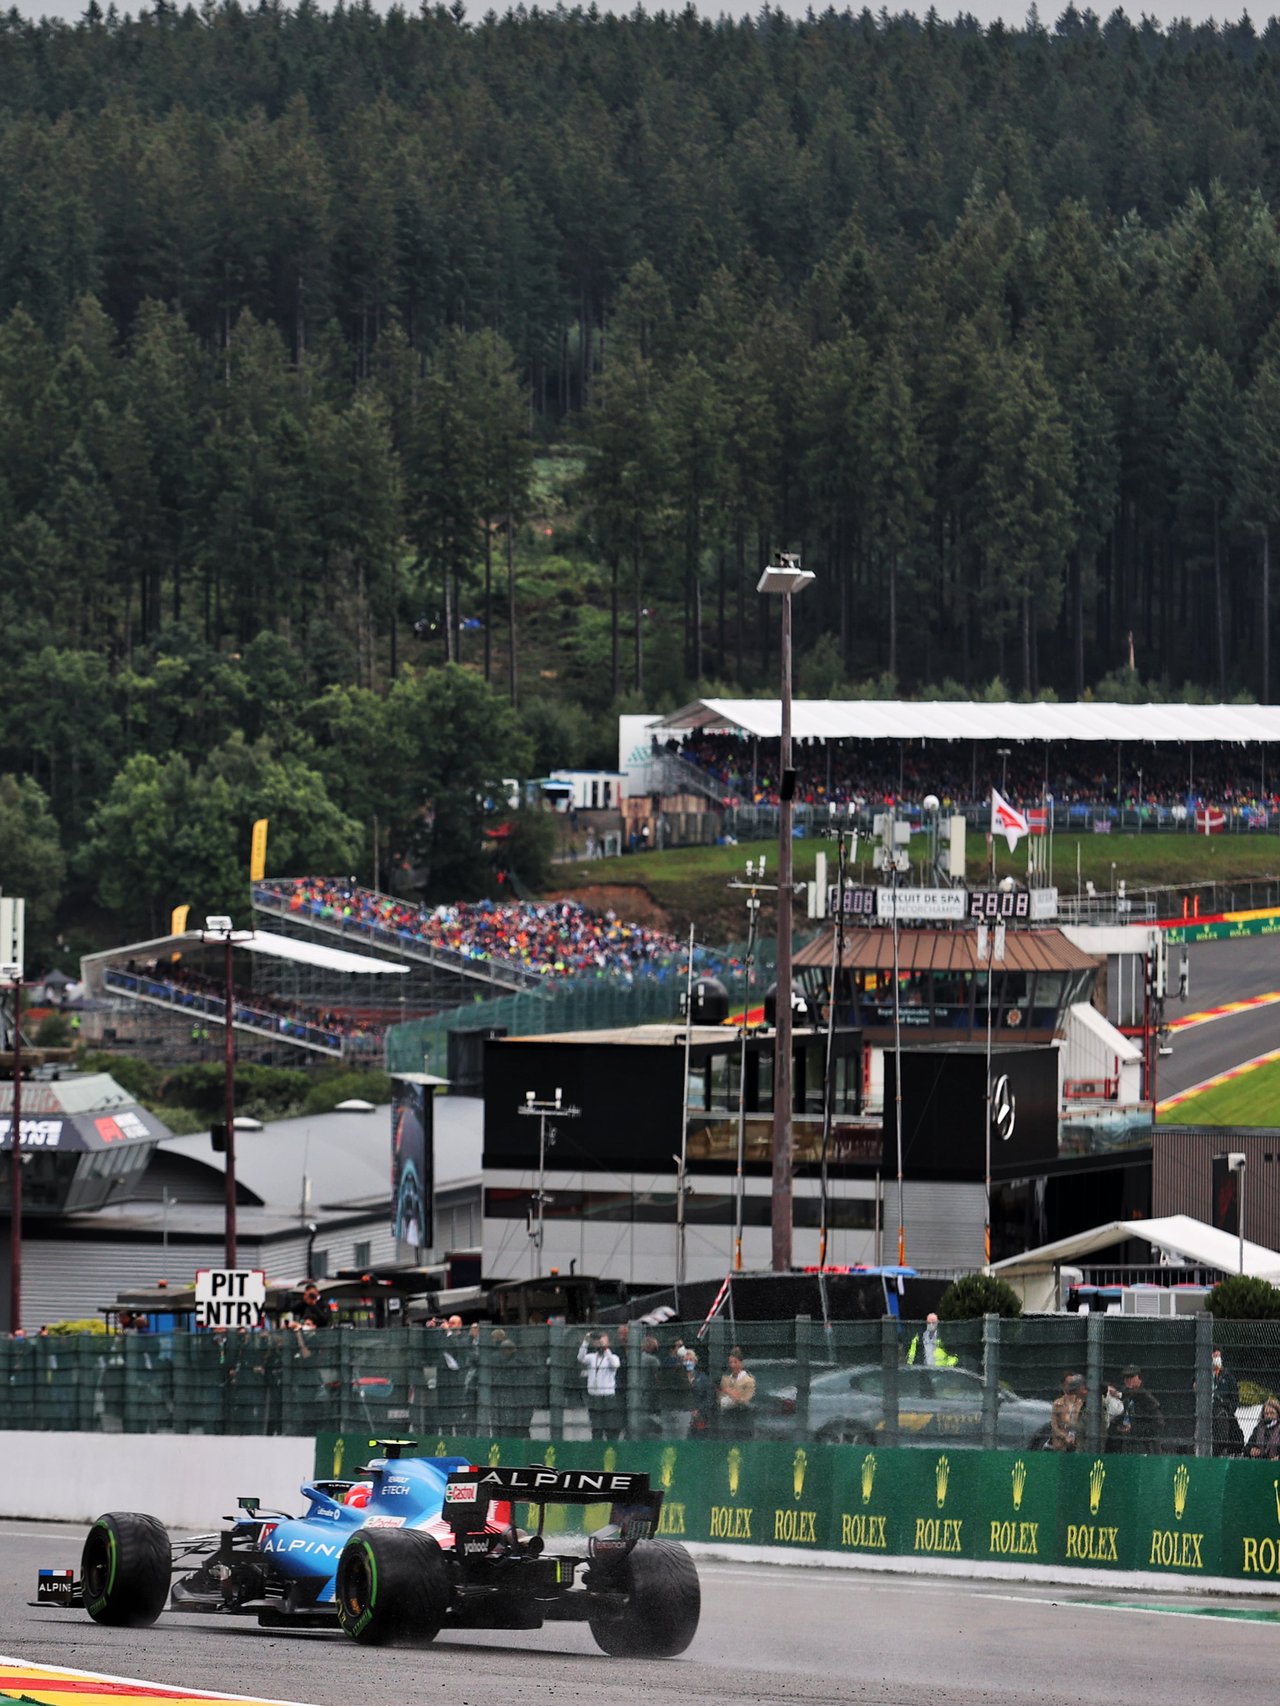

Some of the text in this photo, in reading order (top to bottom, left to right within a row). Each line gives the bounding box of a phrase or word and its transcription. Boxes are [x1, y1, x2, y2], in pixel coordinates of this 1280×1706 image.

[924, 894, 937, 903] DE
[940, 894, 960, 903] SPA
[212, 1273, 249, 1297] PIT
[194, 1301, 265, 1327] ENTRY
[452, 1485, 475, 1499] Castrol
[480, 1470, 632, 1491] ALPINE
[710, 1506, 752, 1538] ROLEX
[774, 1509, 817, 1543] ROLEX
[841, 1514, 887, 1548] ROLEX
[914, 1518, 963, 1552] ROLEX
[463, 1538, 489, 1557] yahoo!
[989, 1520, 1039, 1554] ROLEX
[1065, 1524, 1119, 1562] ROLEX
[1149, 1530, 1204, 1568] ROLEX
[39, 1582, 71, 1592] ALPINE
